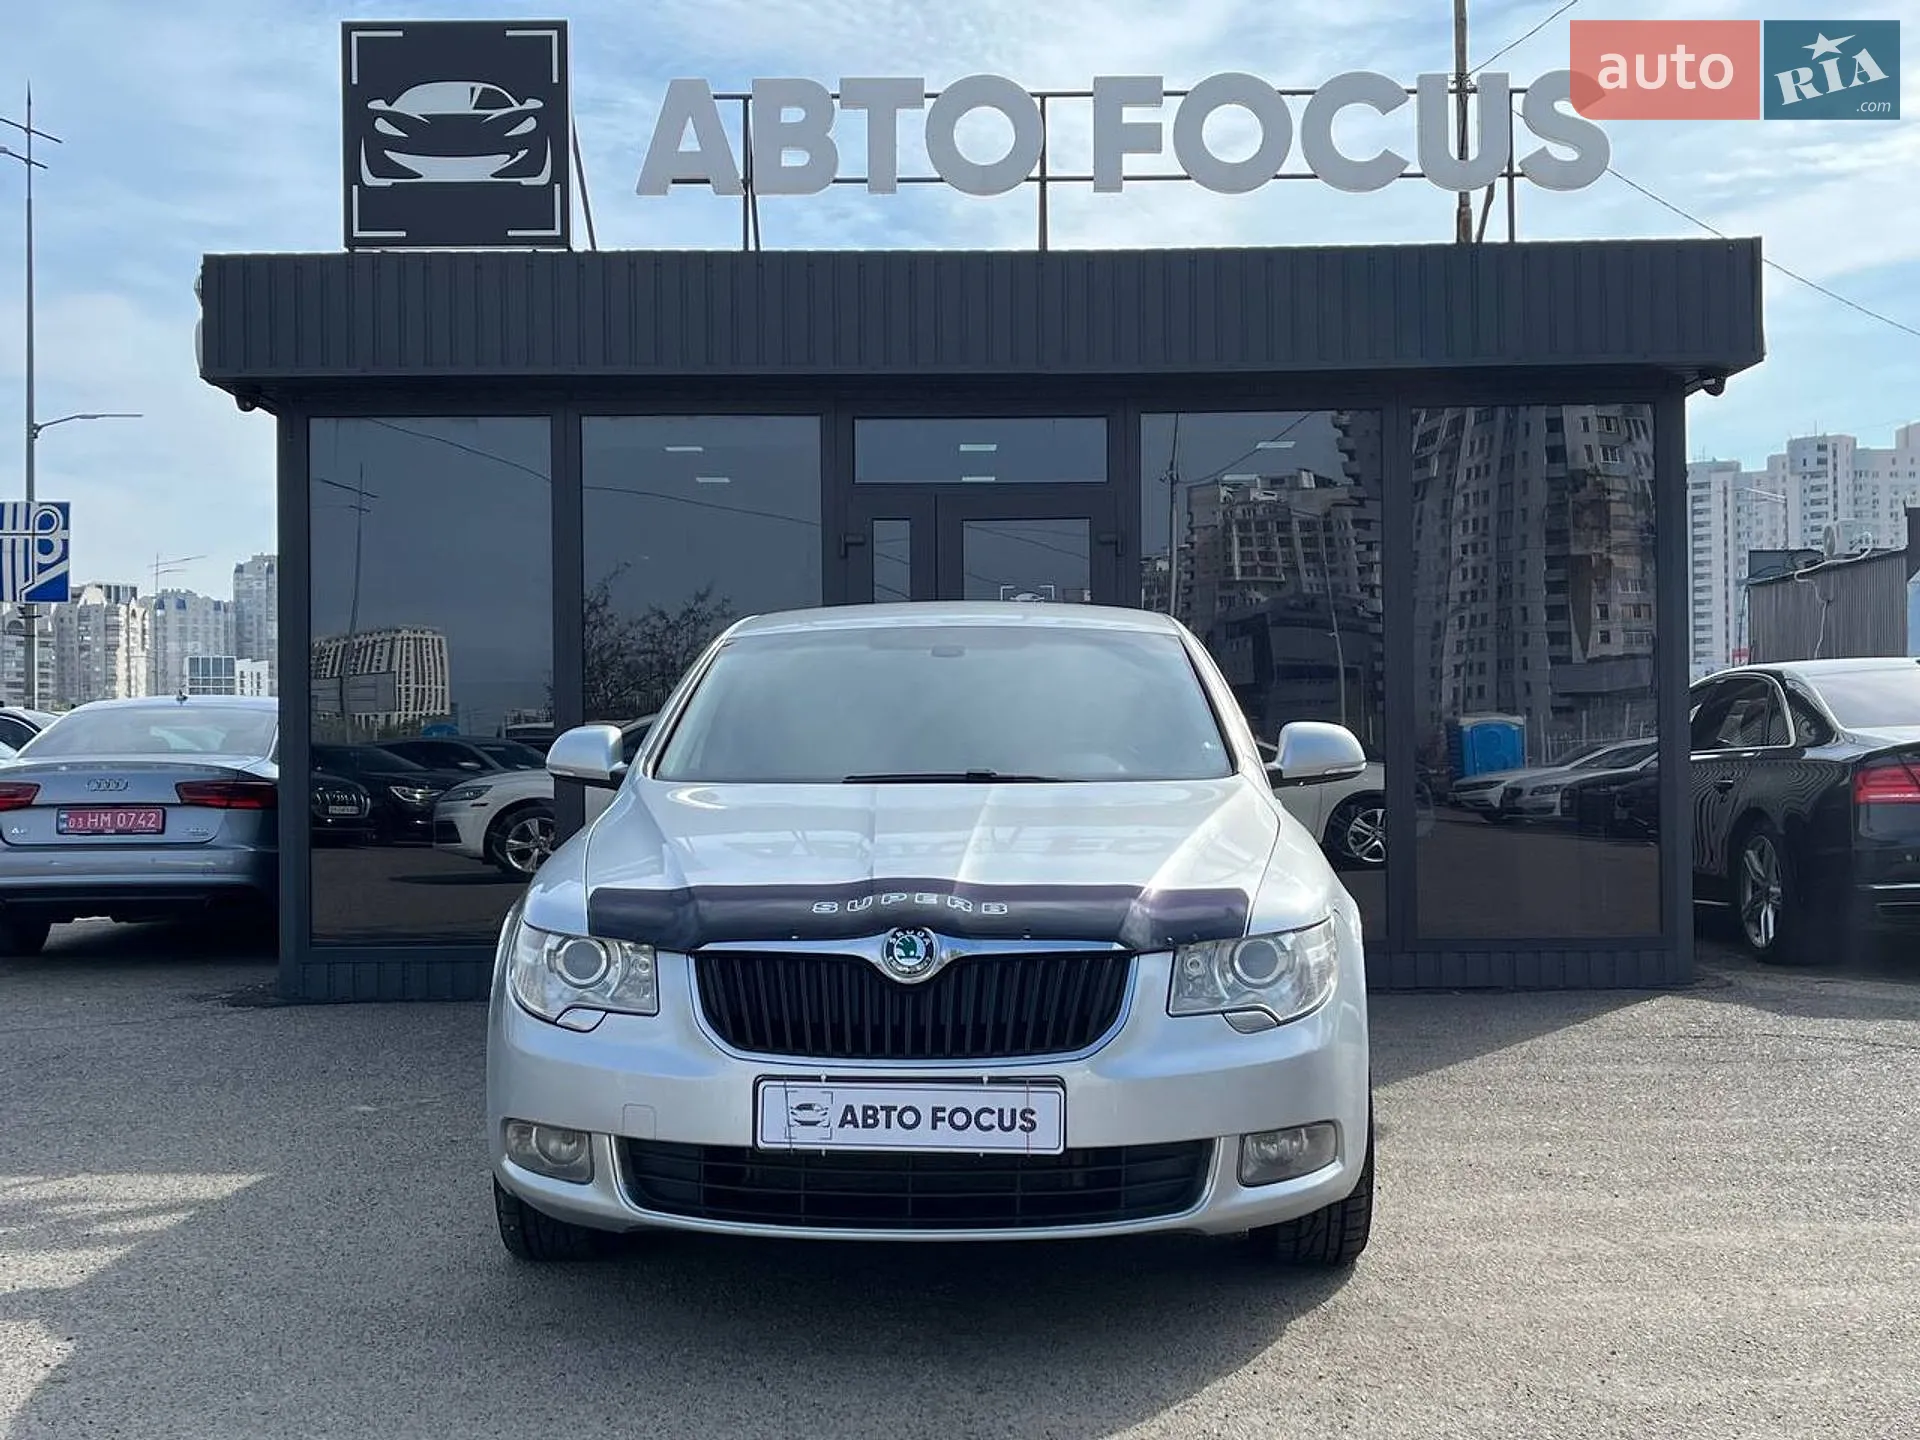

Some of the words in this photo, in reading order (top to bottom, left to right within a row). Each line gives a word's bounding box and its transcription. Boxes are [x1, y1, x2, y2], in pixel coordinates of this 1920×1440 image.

[1093, 71, 1611, 195] FOCUS
[87, 812, 112, 828] HM
[117, 812, 157, 828] 0742
[812, 892, 1008, 915] SUPERB
[931, 1105, 1037, 1133] FOCUS
